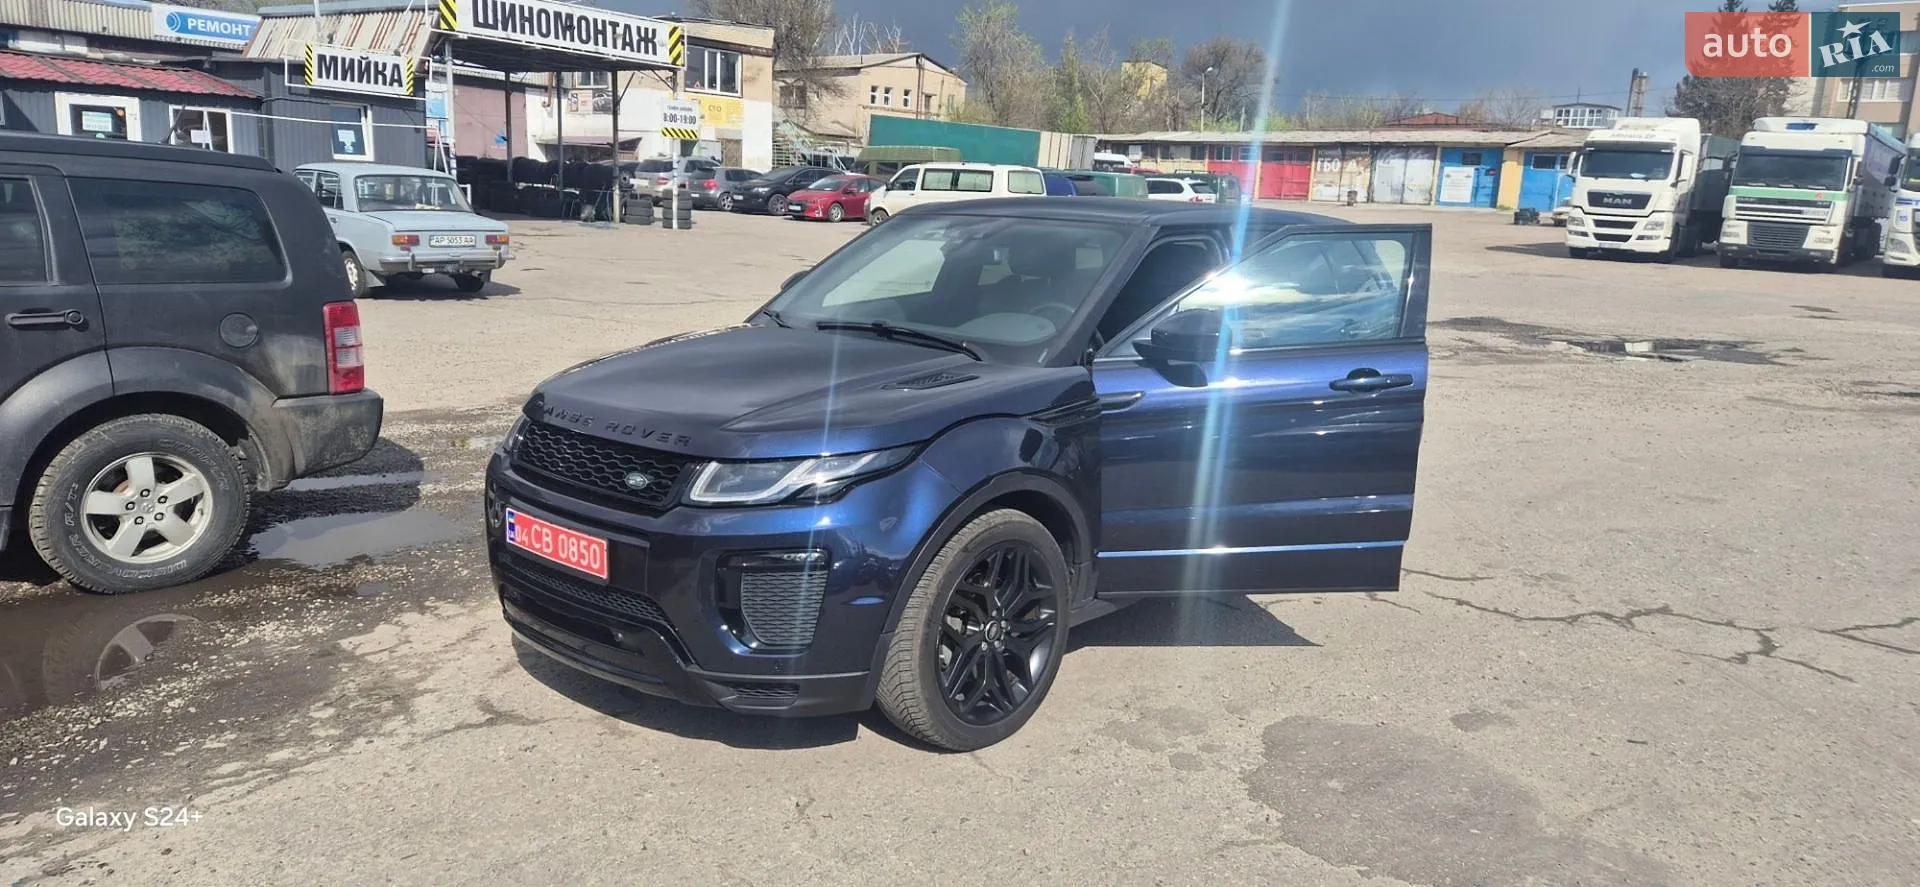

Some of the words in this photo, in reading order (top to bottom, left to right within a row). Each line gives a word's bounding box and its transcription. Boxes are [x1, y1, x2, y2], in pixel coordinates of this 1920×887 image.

[187, 17, 252, 37] РЕМОНТ
[472, 0, 657, 56] ШИНОМОНТАЖ
[317, 53, 403, 88] МИЙКА
[1602, 197, 1632, 205] MAN
[605, 419, 692, 448] ROVER
[515, 525, 529, 547] 04
[531, 523, 553, 554] CB
[557, 533, 600, 570] 0850
